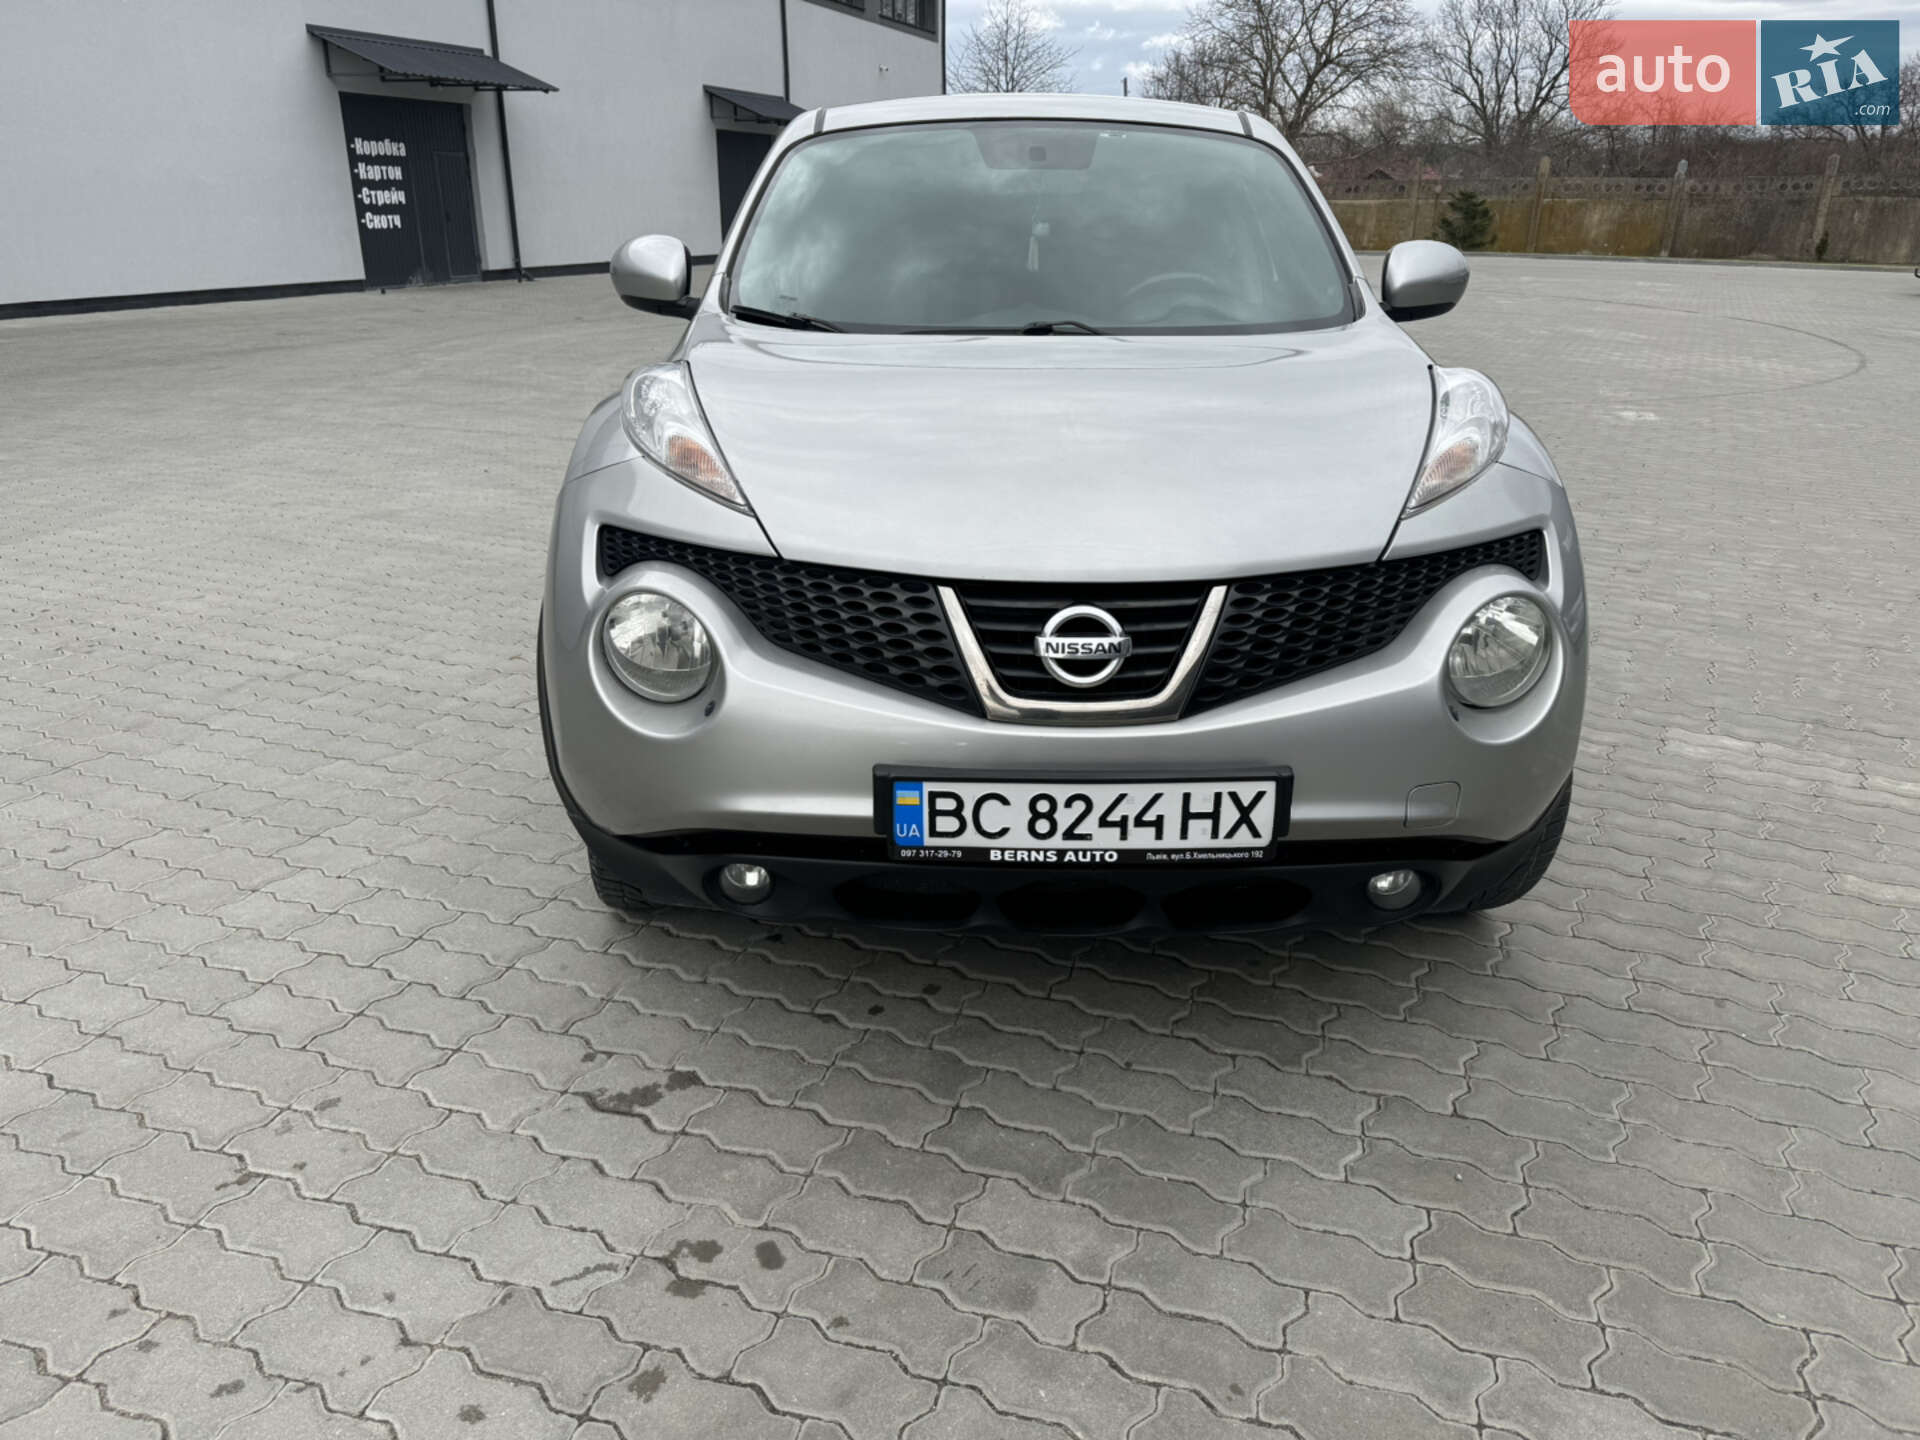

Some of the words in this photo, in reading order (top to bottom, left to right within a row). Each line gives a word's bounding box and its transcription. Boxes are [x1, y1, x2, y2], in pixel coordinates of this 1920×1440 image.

[1045, 642, 1121, 655] NISSAN
[928, 790, 1011, 840] BC
[1027, 792, 1164, 841] 8244
[1180, 790, 1267, 840] HX
[896, 823, 920, 837] UA
[900, 849, 916, 857] 097
[919, 849, 962, 858] 317-29-79
[990, 849, 1058, 862] BERNS
[1064, 850, 1119, 862] AUTO
[1251, 850, 1264, 858] 192
